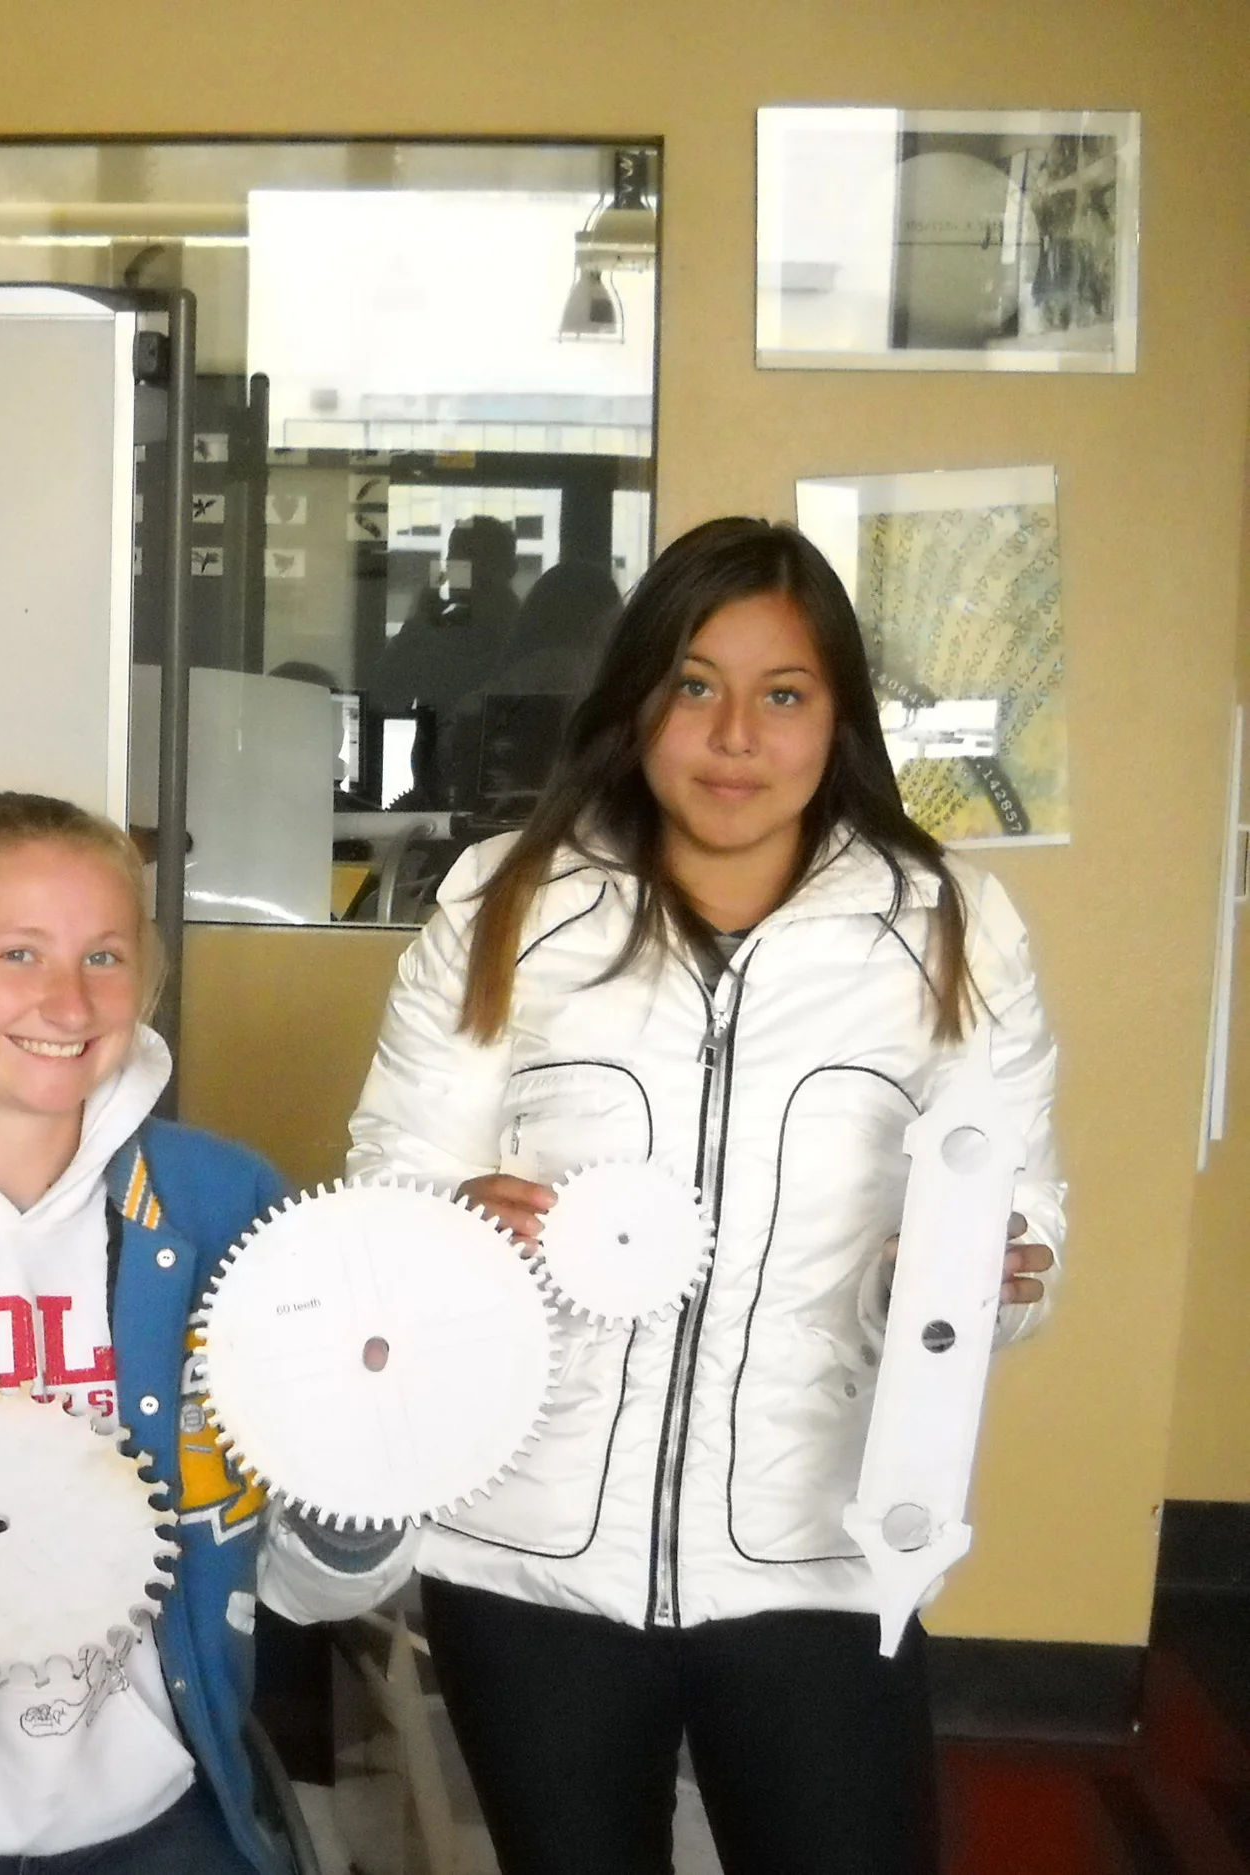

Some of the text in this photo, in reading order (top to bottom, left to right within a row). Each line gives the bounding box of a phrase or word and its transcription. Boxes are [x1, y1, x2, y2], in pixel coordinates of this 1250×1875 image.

[975, 762, 1023, 834] .142857
[276, 1297, 322, 1316] 60 teeth
